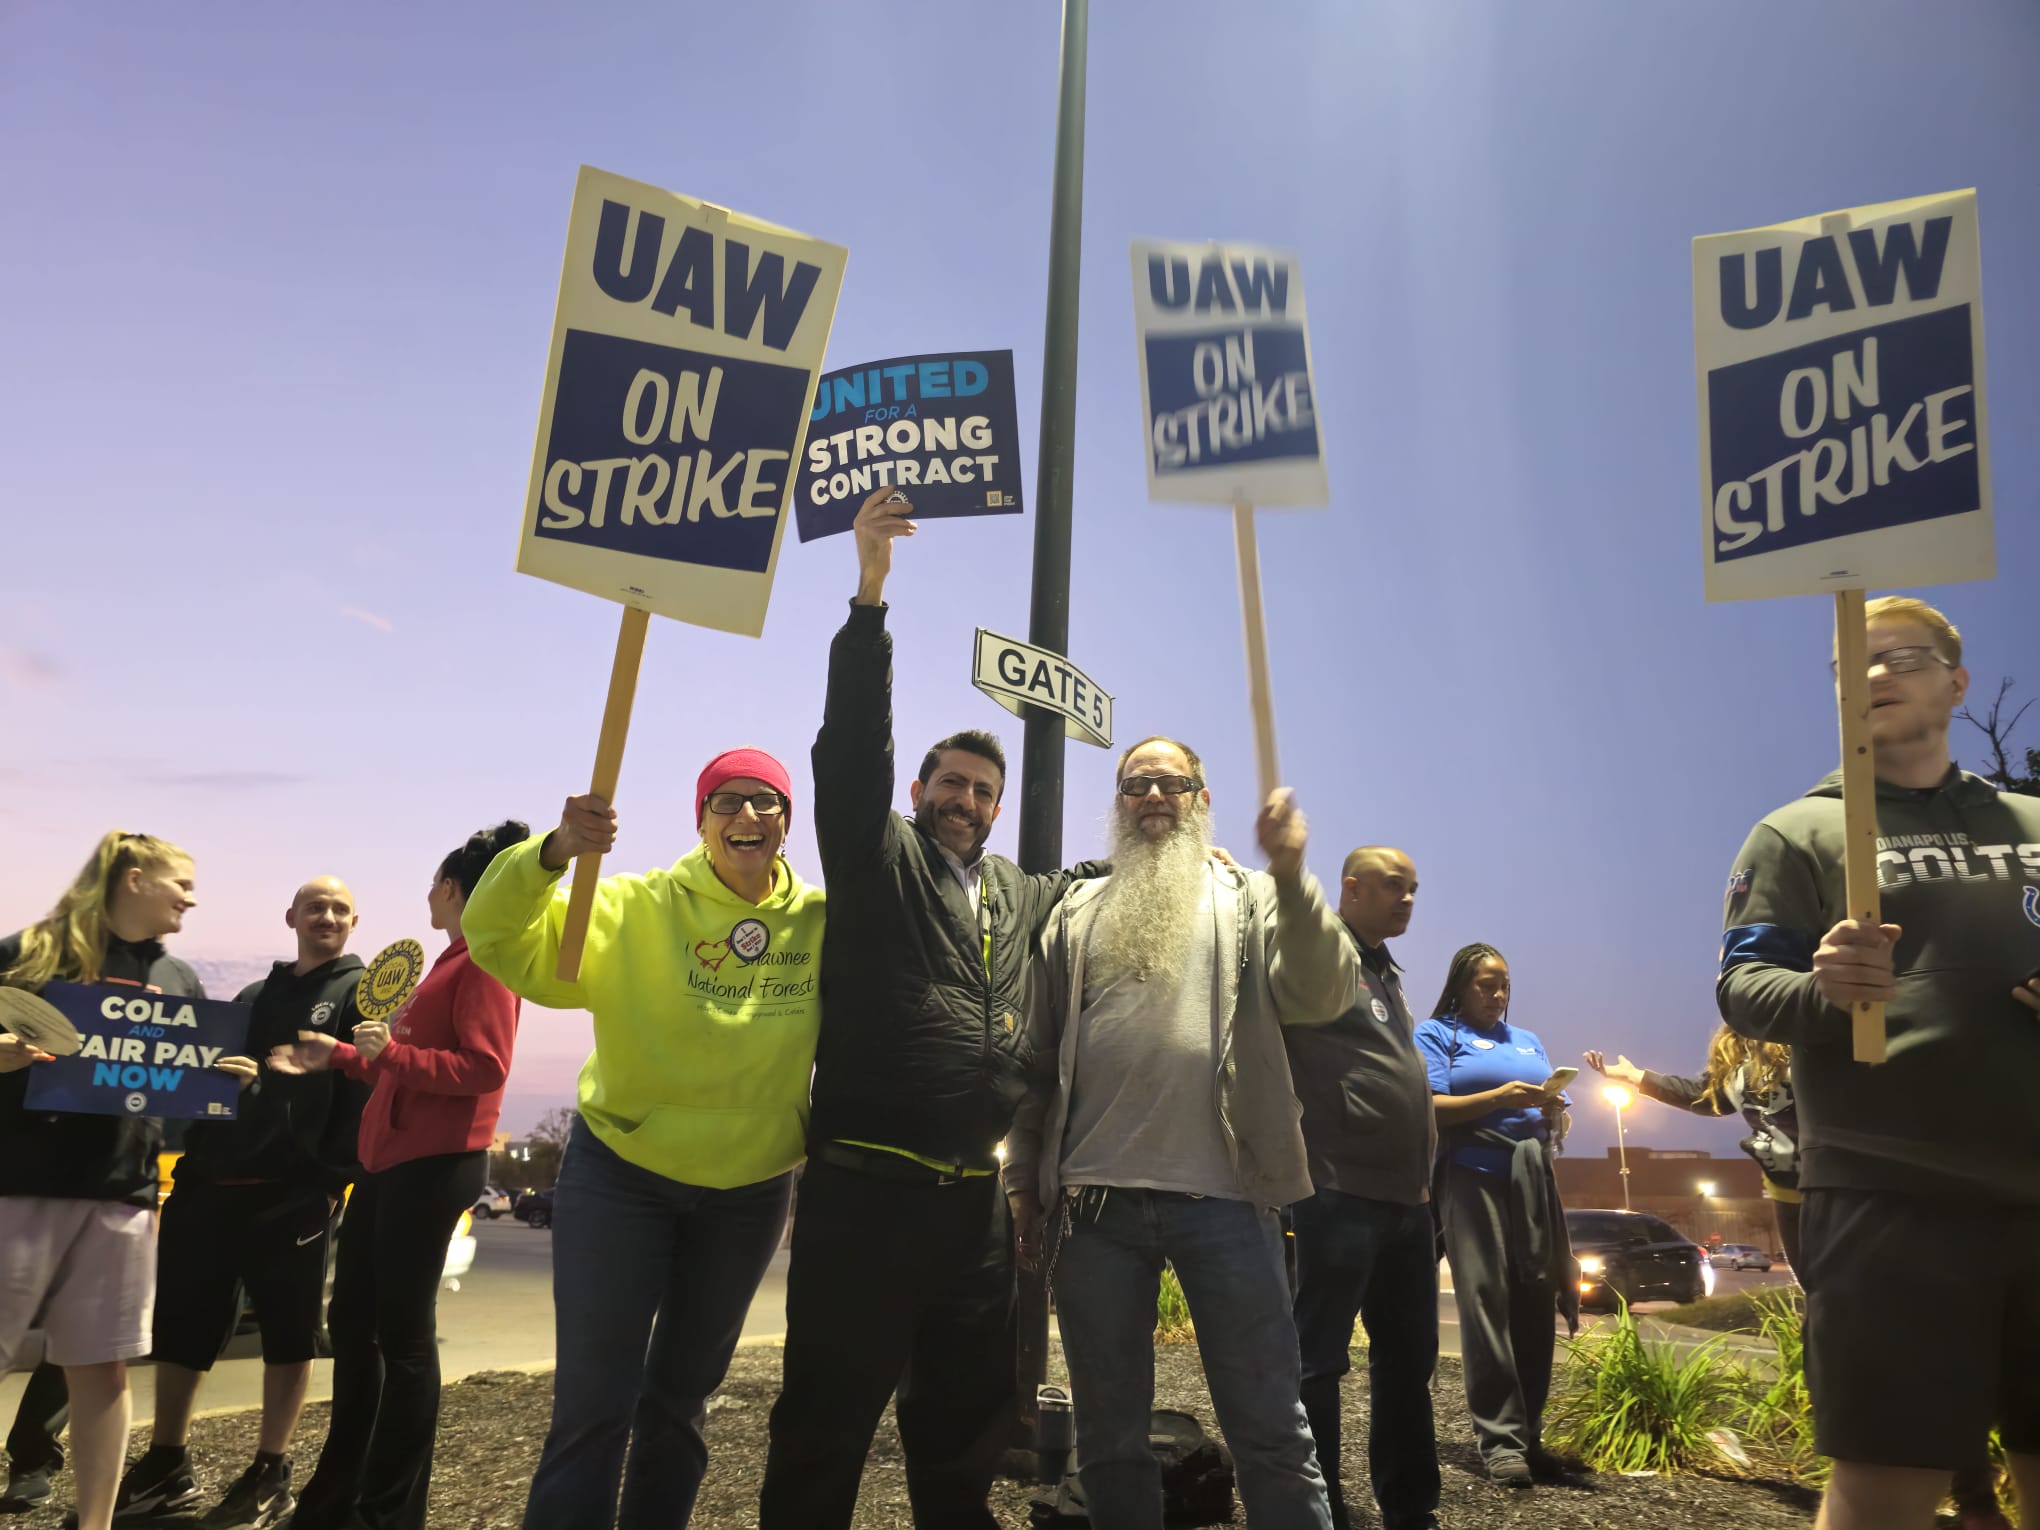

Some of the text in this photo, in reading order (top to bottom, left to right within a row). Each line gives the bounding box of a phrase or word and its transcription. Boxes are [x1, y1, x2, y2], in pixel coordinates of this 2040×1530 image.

[593, 199, 822, 352] UAW
[1148, 252, 1289, 320] UAW
[1719, 216, 1953, 330] UAW
[810, 360, 989, 421] UNITED
[1193, 327, 1255, 400] ON
[1780, 336, 1880, 438] ON
[622, 366, 724, 445] ON
[864, 403, 917, 424] FOR A
[1154, 371, 1314, 469] STRIKE
[808, 415, 993, 473] STRONG
[1714, 384, 1975, 552] STRIKE
[541, 449, 790, 530] STRIKE
[810, 455, 999, 505] CONTRACT
[998, 648, 1103, 729] GATE 5
[1876, 833, 1969, 851] DIANAPOLIS
[1876, 843, 2040, 888] COLTS
[376, 967, 405, 987] UAW
[688, 969, 814, 998] National Forest
[101, 996, 198, 1028] COLA
[128, 1025, 165, 1038] AND
[93, 1063, 184, 1092] NOW
[154, 1041, 223, 1068] PAY
